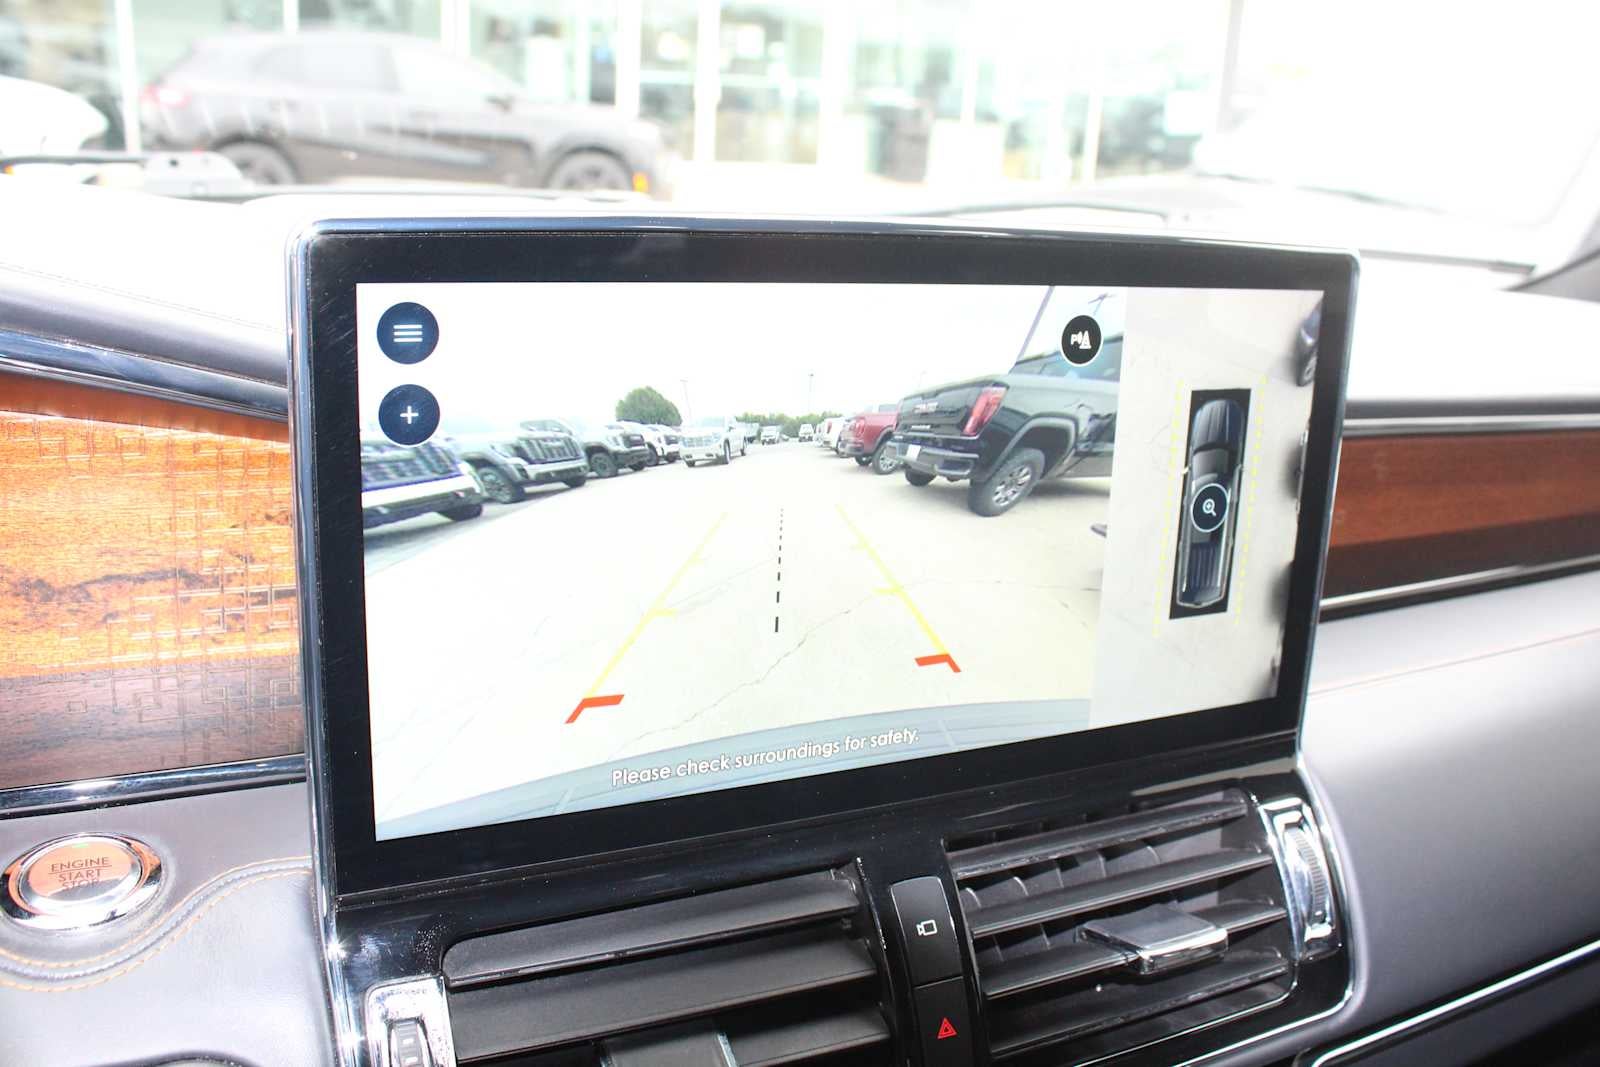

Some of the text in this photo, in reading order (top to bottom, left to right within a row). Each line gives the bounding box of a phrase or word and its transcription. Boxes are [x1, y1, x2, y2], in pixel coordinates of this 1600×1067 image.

[612, 727, 919, 786] Please check surroundings for safety.
[51, 856, 109, 872] ENGINE
[59, 868, 102, 882] START
